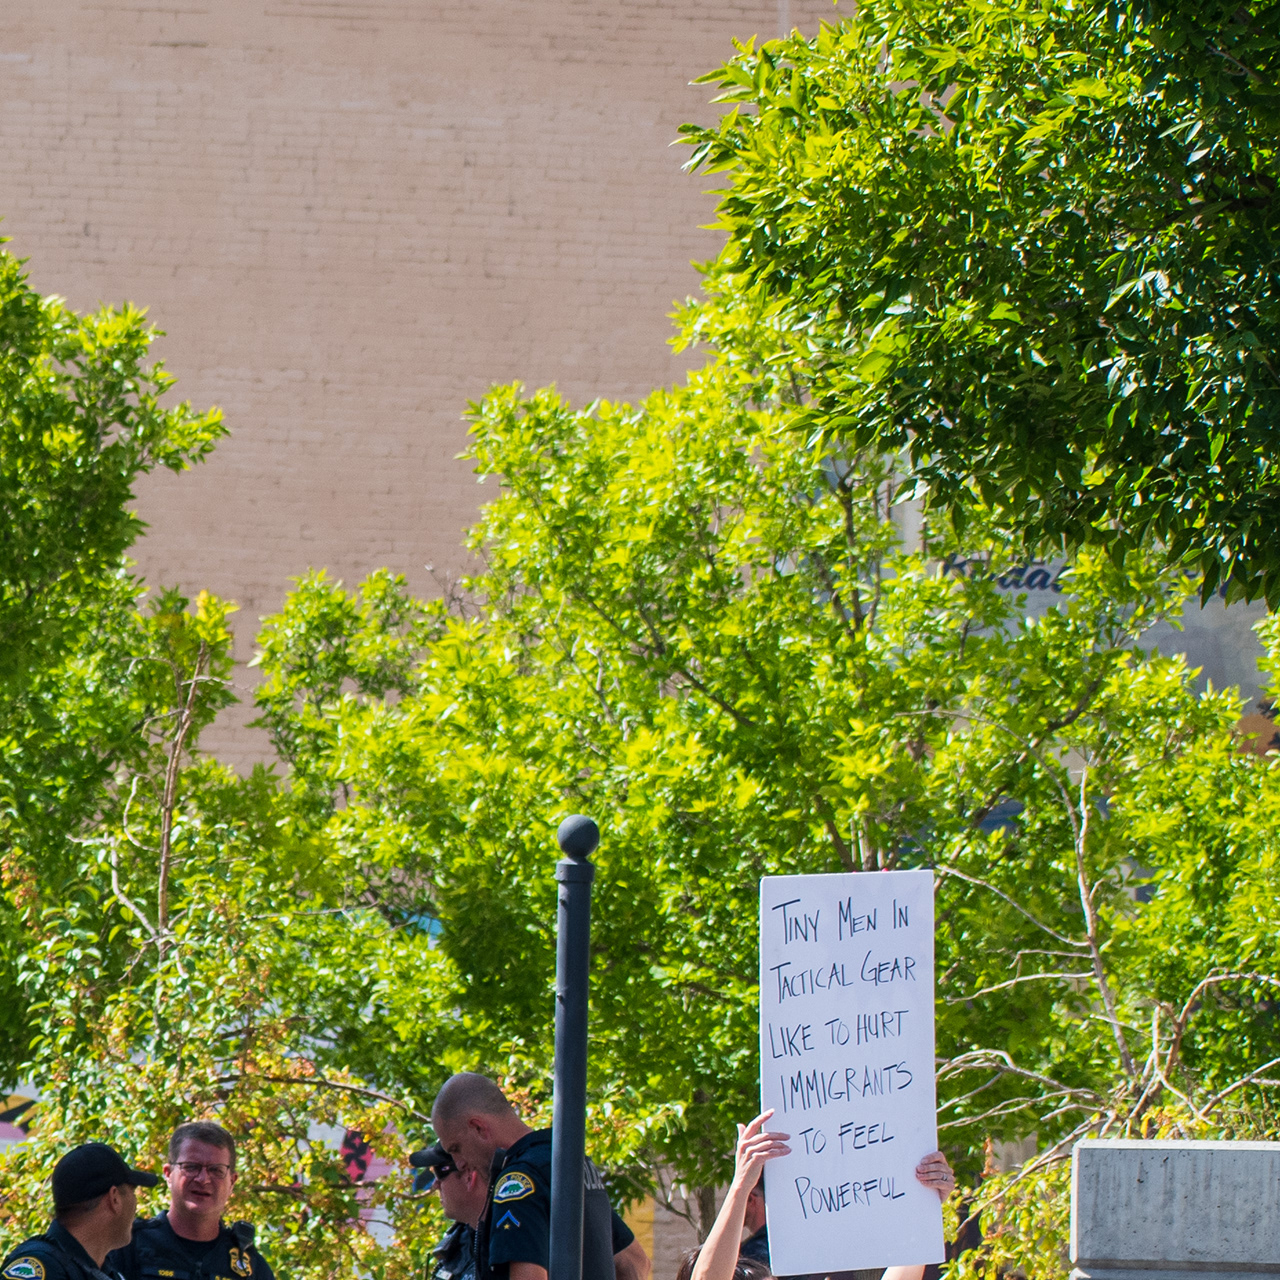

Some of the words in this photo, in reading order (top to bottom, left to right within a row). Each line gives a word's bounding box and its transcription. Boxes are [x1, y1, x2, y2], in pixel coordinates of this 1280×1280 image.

[771, 898, 820, 944] TINY
[838, 897, 878, 942] MEN
[893, 898, 910, 929] IN
[770, 961, 854, 1004] TACTICAL
[860, 949, 917, 985] GEAR
[768, 1022, 815, 1059] LIKE
[824, 1017, 850, 1047] TO
[856, 1009, 910, 1040] HURT
[780, 1060, 913, 1114] IMMIGRANTS
[799, 1127, 826, 1155] TO
[838, 1121, 895, 1154] FEEL
[795, 1176, 906, 1220] POWERFUL
